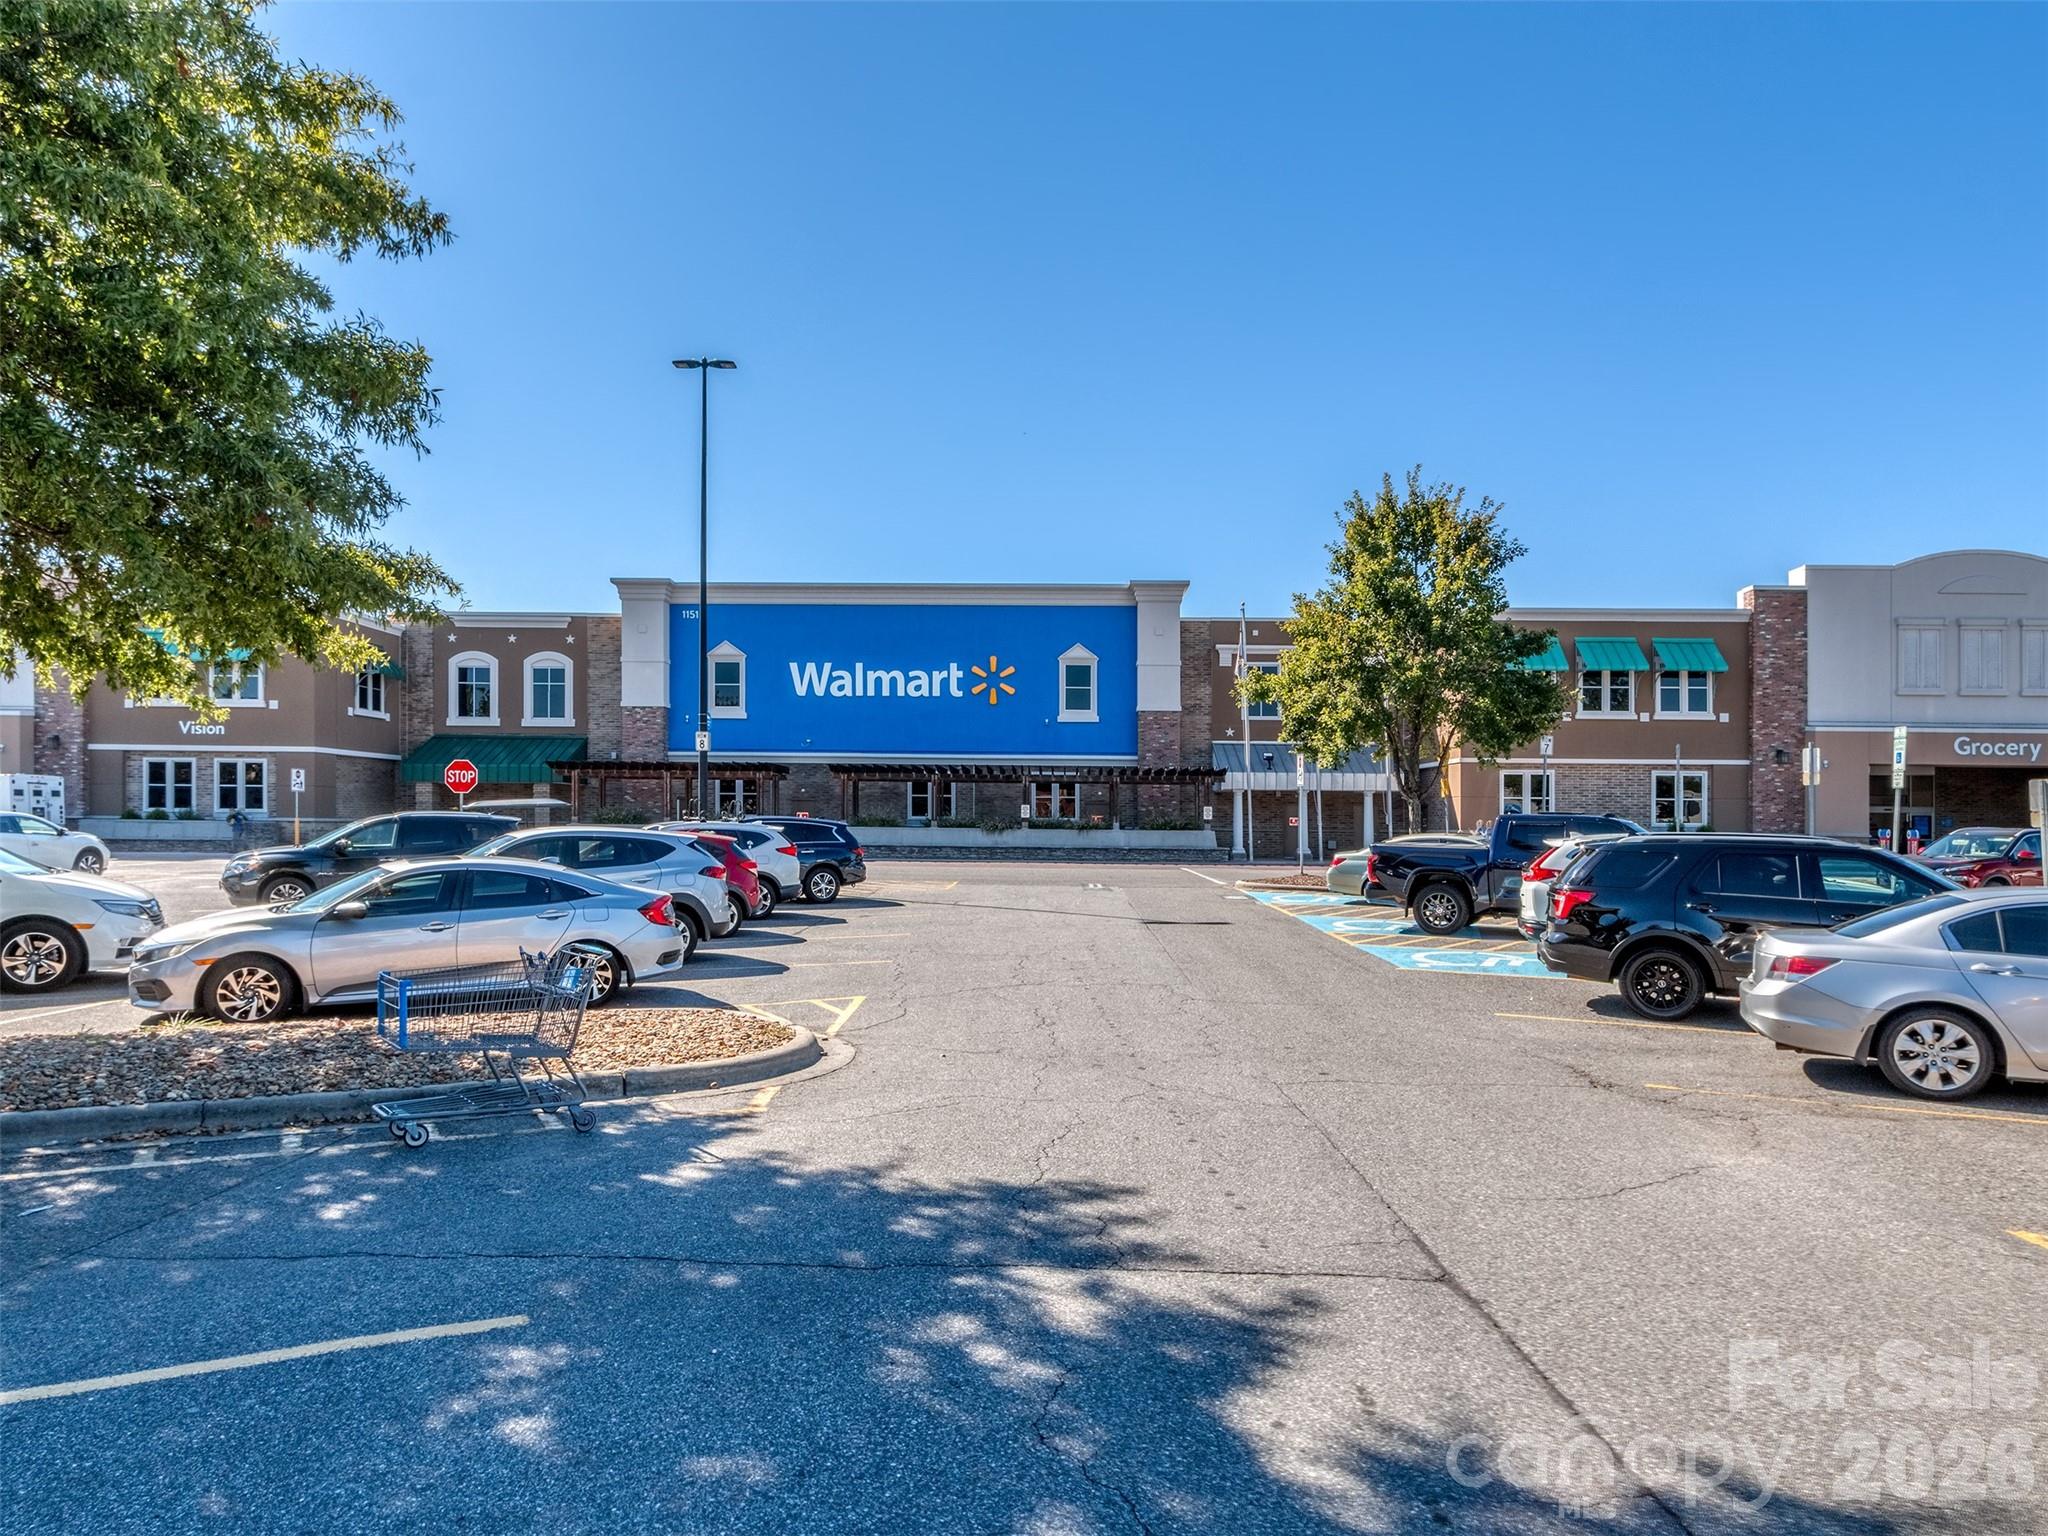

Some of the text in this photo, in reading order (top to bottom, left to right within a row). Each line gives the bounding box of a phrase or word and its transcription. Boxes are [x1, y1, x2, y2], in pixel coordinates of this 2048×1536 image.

[682, 610, 699, 619] 1151
[789, 662, 963, 697] Walmart
[178, 720, 225, 735] Vision
[699, 739, 705, 749] 8
[1544, 743, 1550, 752] 7
[1953, 736, 2042, 762] Grocery
[447, 769, 475, 783] STOP
